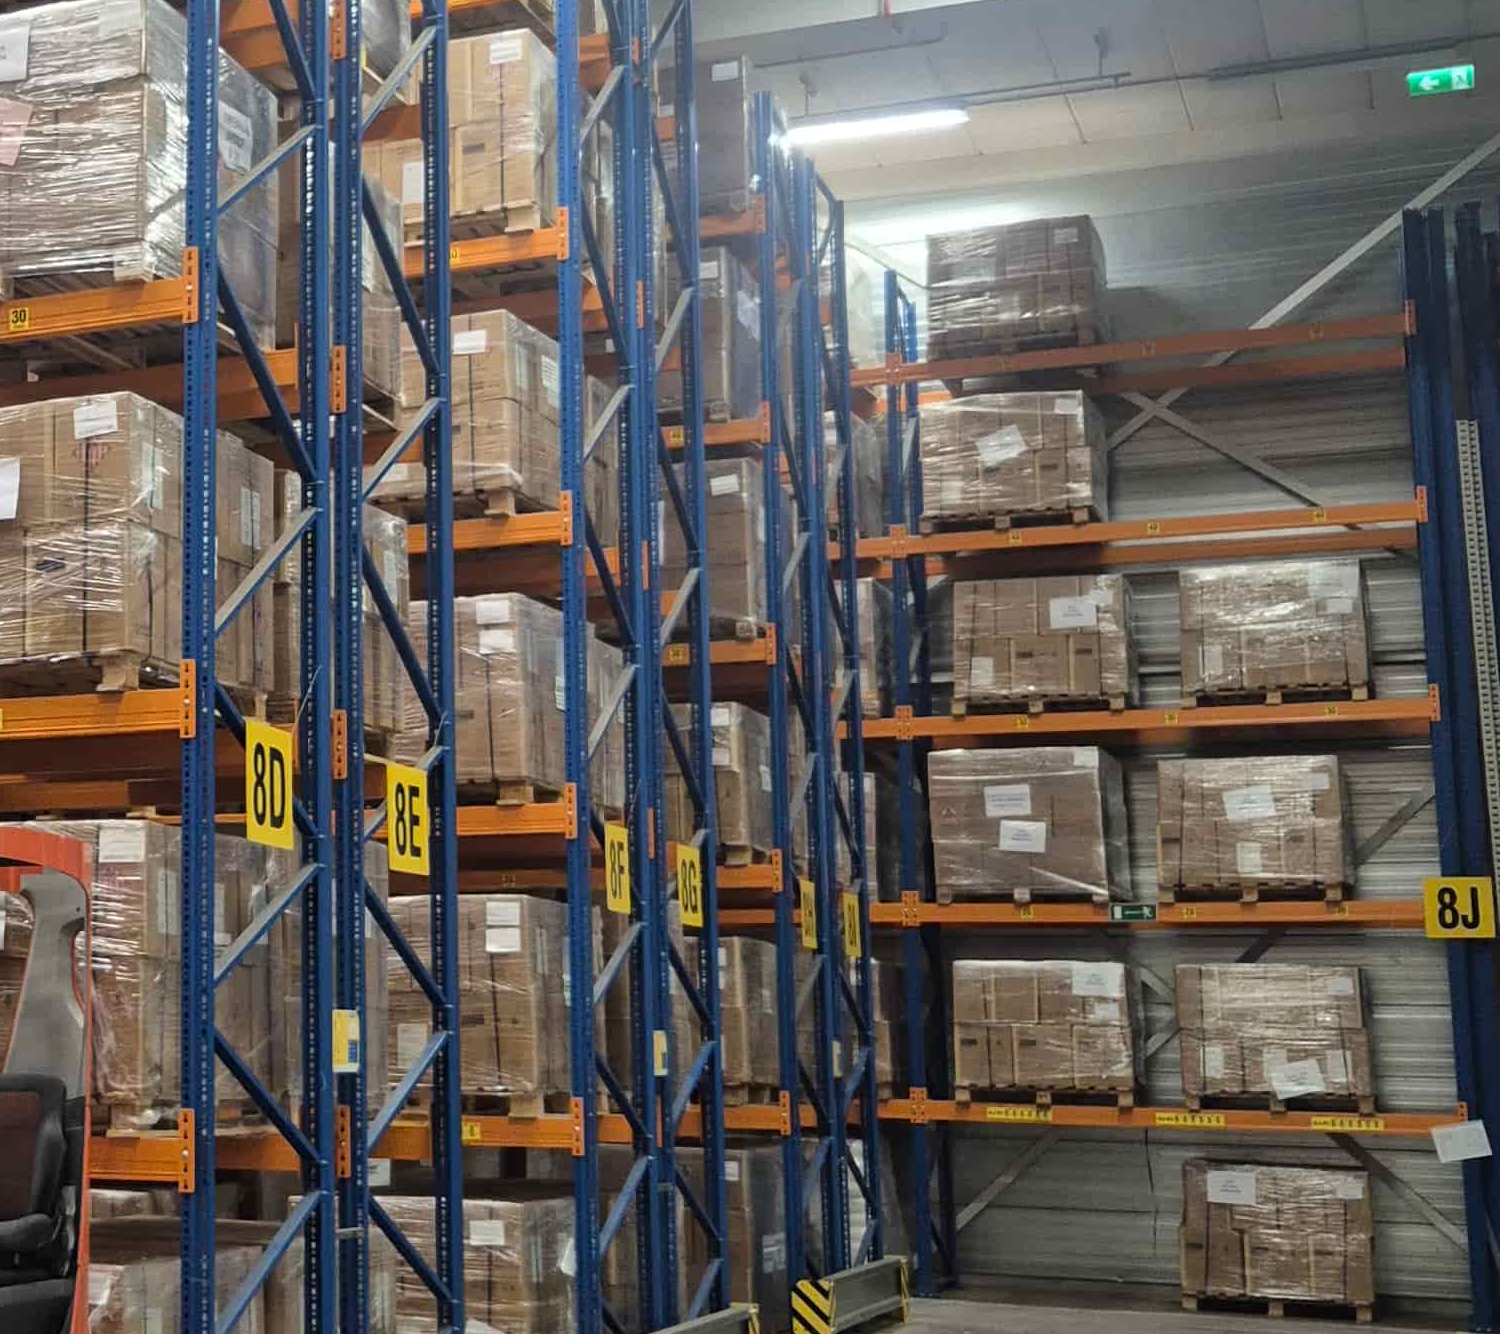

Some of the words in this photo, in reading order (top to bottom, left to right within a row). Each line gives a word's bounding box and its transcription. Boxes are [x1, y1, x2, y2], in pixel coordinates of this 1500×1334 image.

[12, 309, 27, 324] 30
[253, 742, 286, 830] 8D
[393, 781, 421, 858] 8E
[608, 837, 625, 900] 8F
[680, 857, 698, 915] 8G
[1437, 886, 1481, 931] 8J
